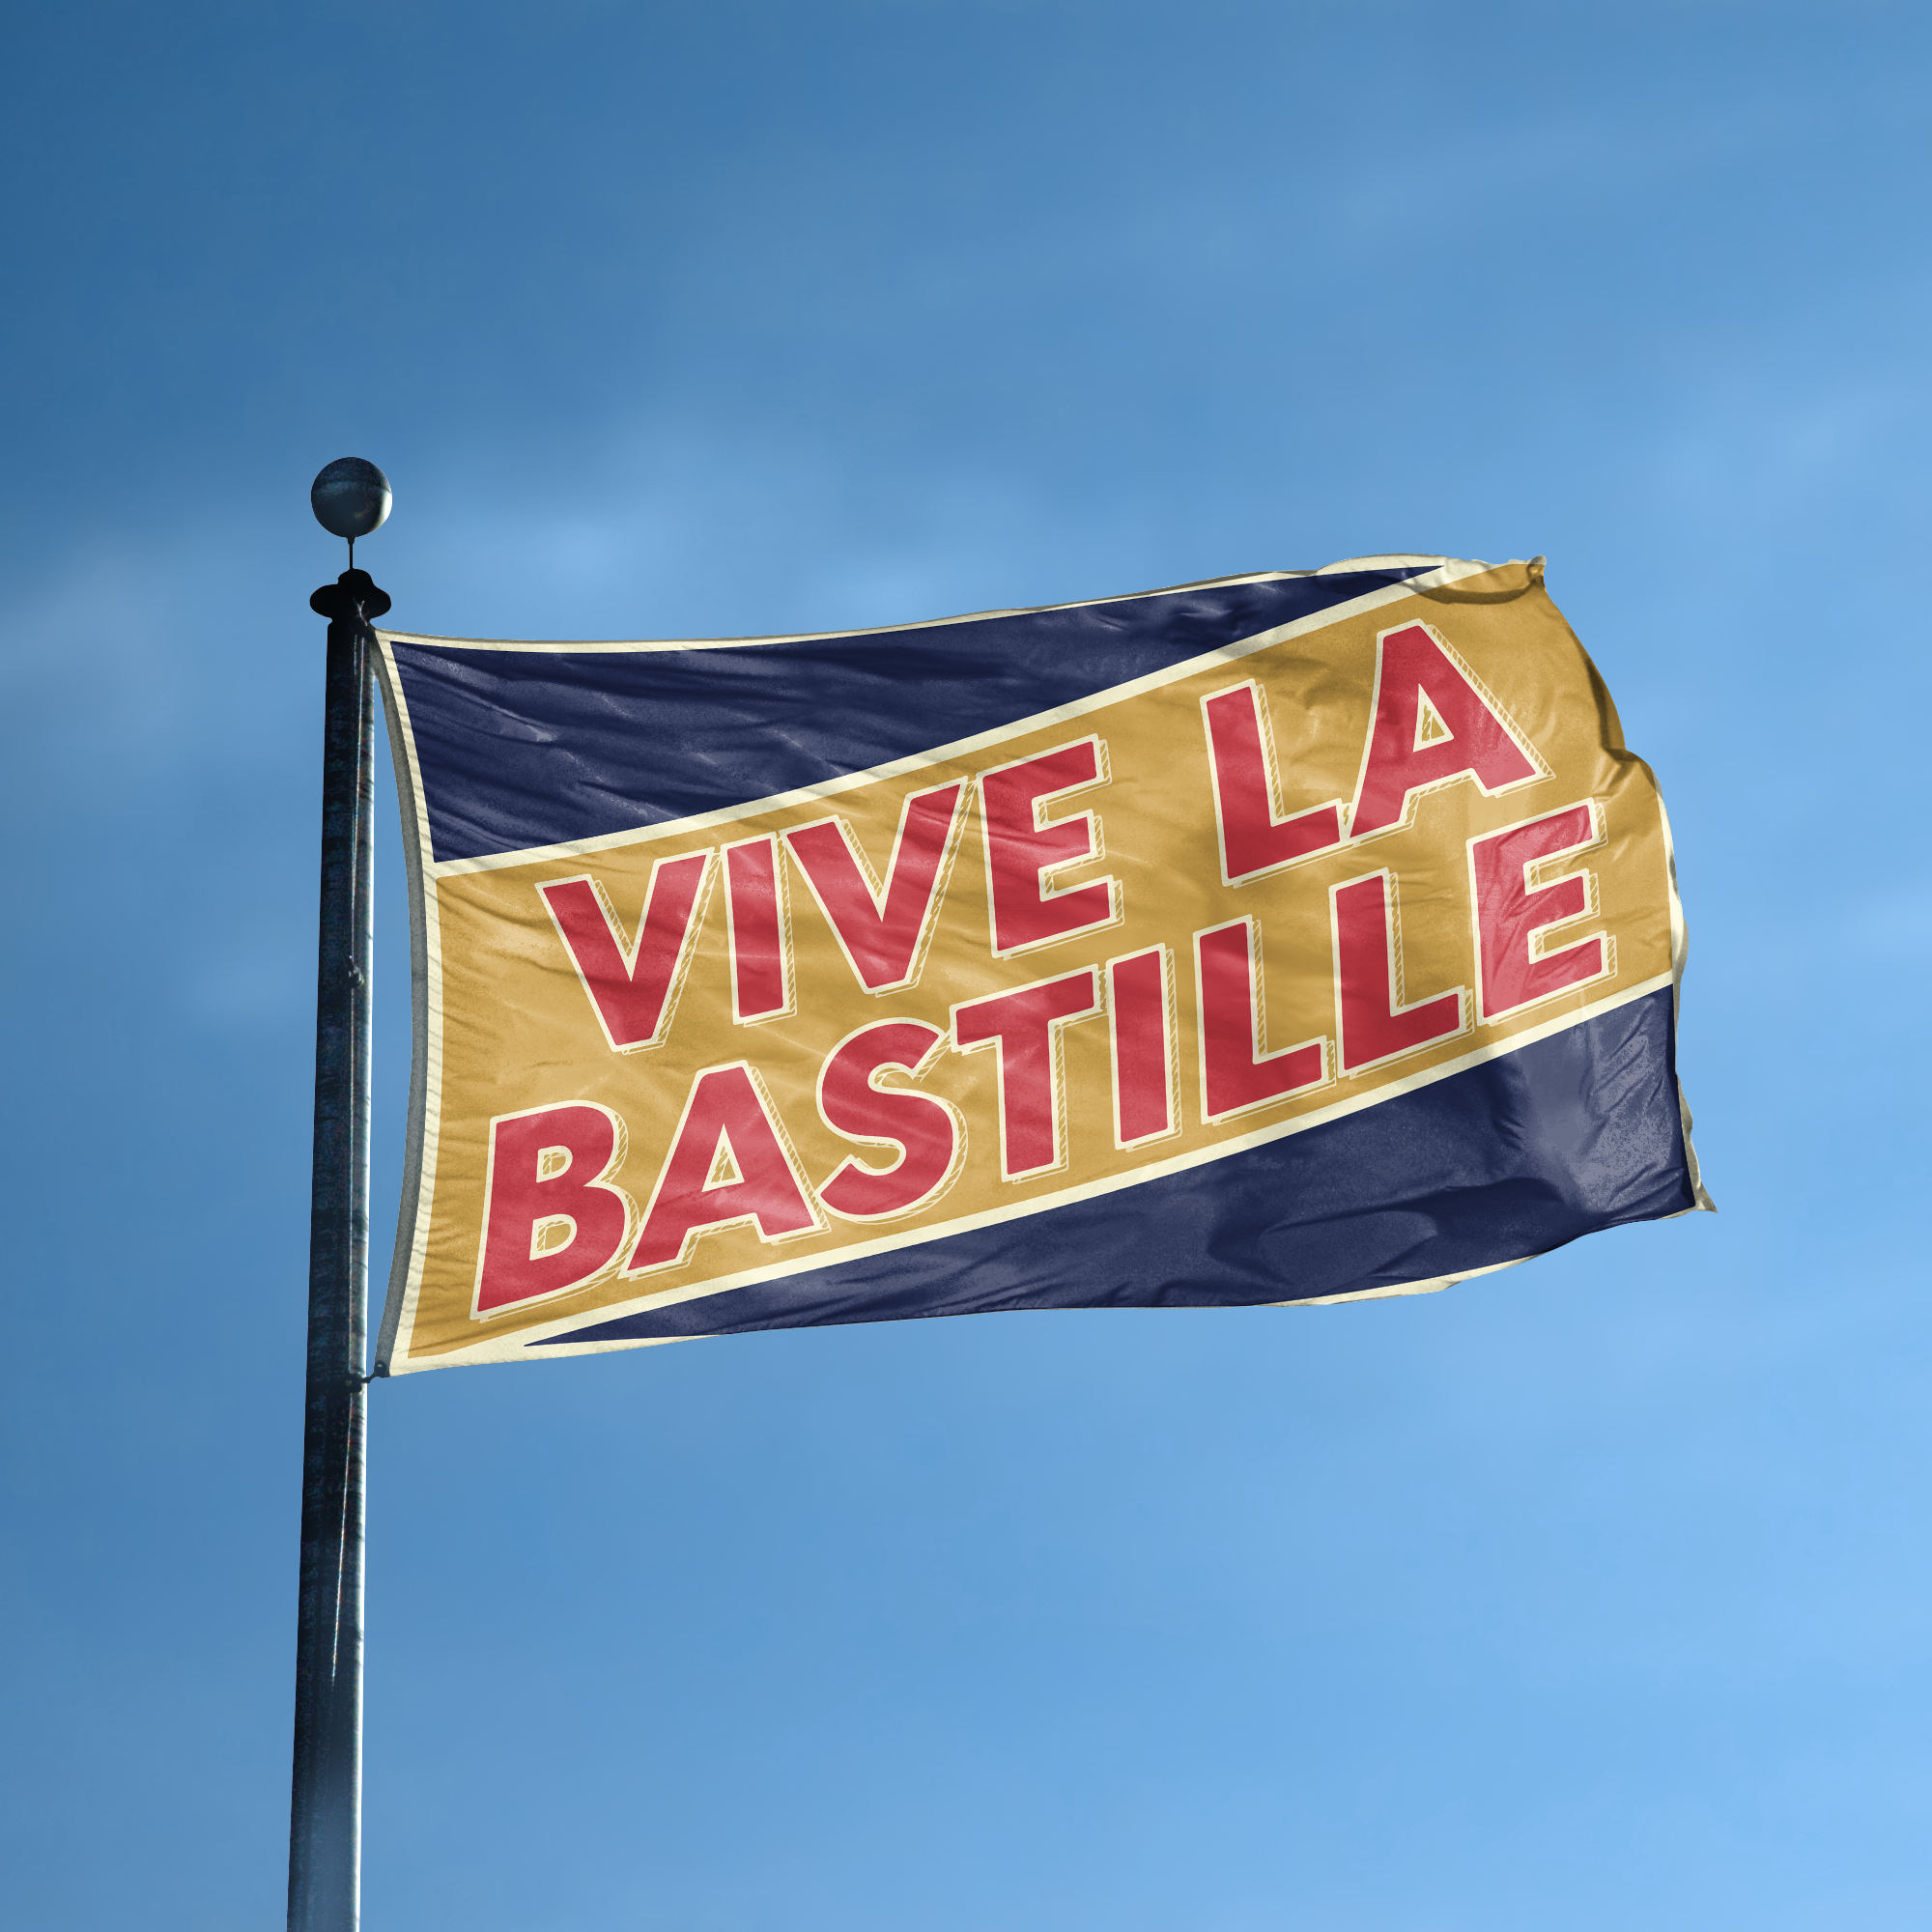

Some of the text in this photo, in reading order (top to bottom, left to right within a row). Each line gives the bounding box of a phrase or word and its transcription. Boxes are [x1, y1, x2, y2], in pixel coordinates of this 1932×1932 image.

[469, 799, 1616, 1321] BASTILLE
[535, 618, 1553, 1055] VIVE LA
